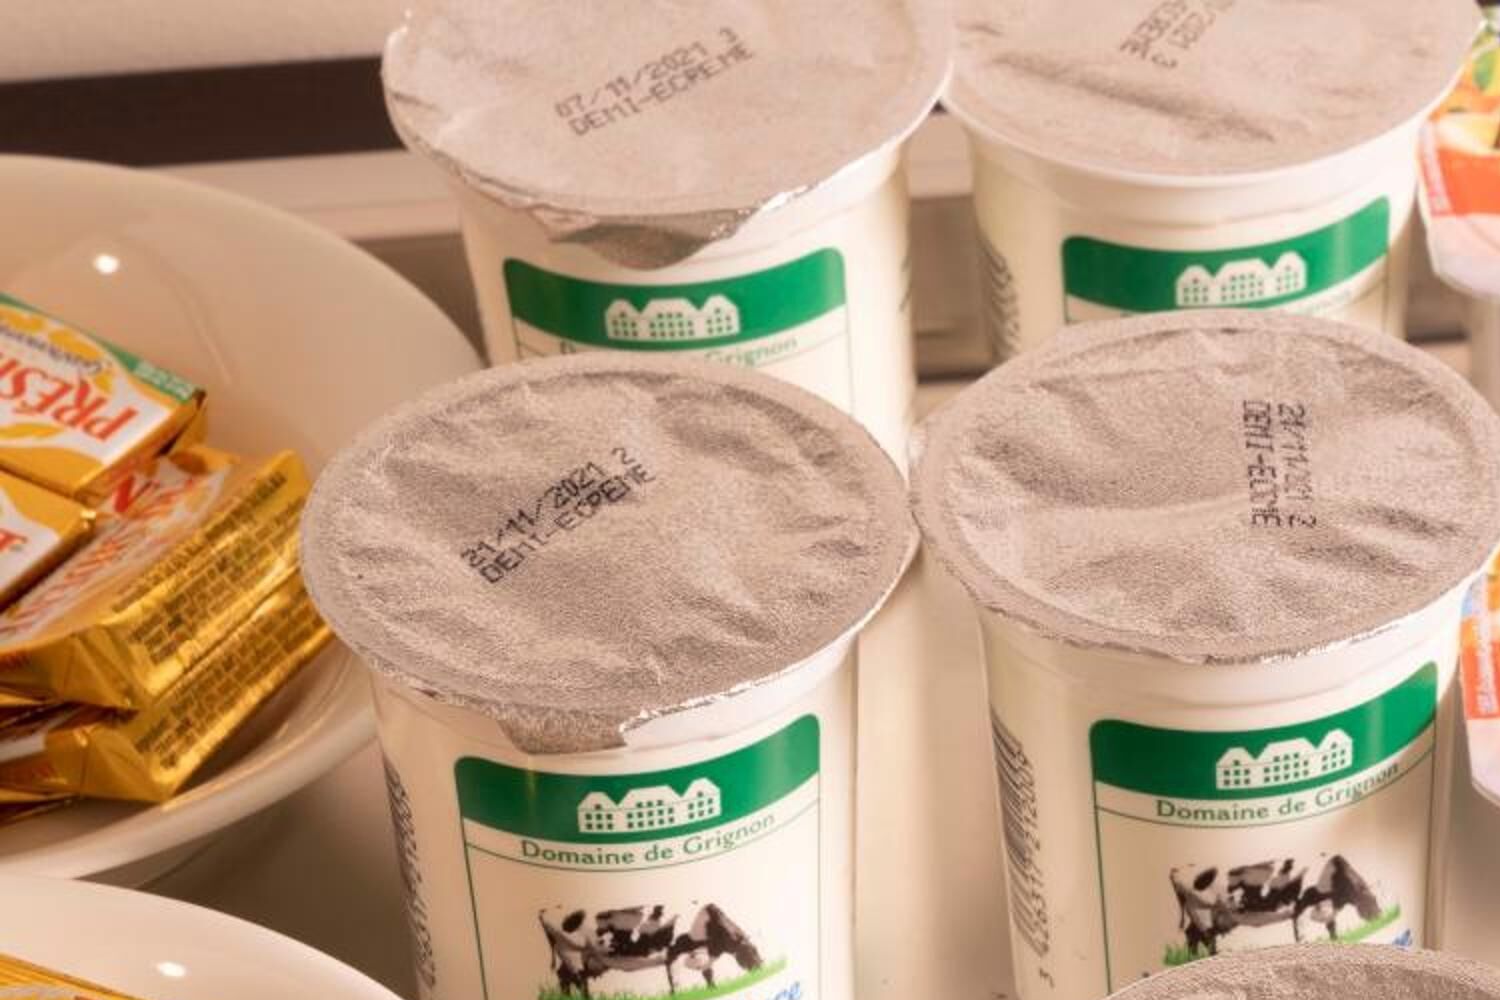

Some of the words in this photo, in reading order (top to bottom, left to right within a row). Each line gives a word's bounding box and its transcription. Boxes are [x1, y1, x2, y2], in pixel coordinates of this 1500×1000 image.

[1156, 799, 1268, 821] Domaine
[1278, 798, 1306, 815] de
[1314, 762, 1401, 808] Grignon
[520, 839, 635, 866] Domaine
[644, 845, 674, 863] de
[683, 814, 776, 855] Grignon
